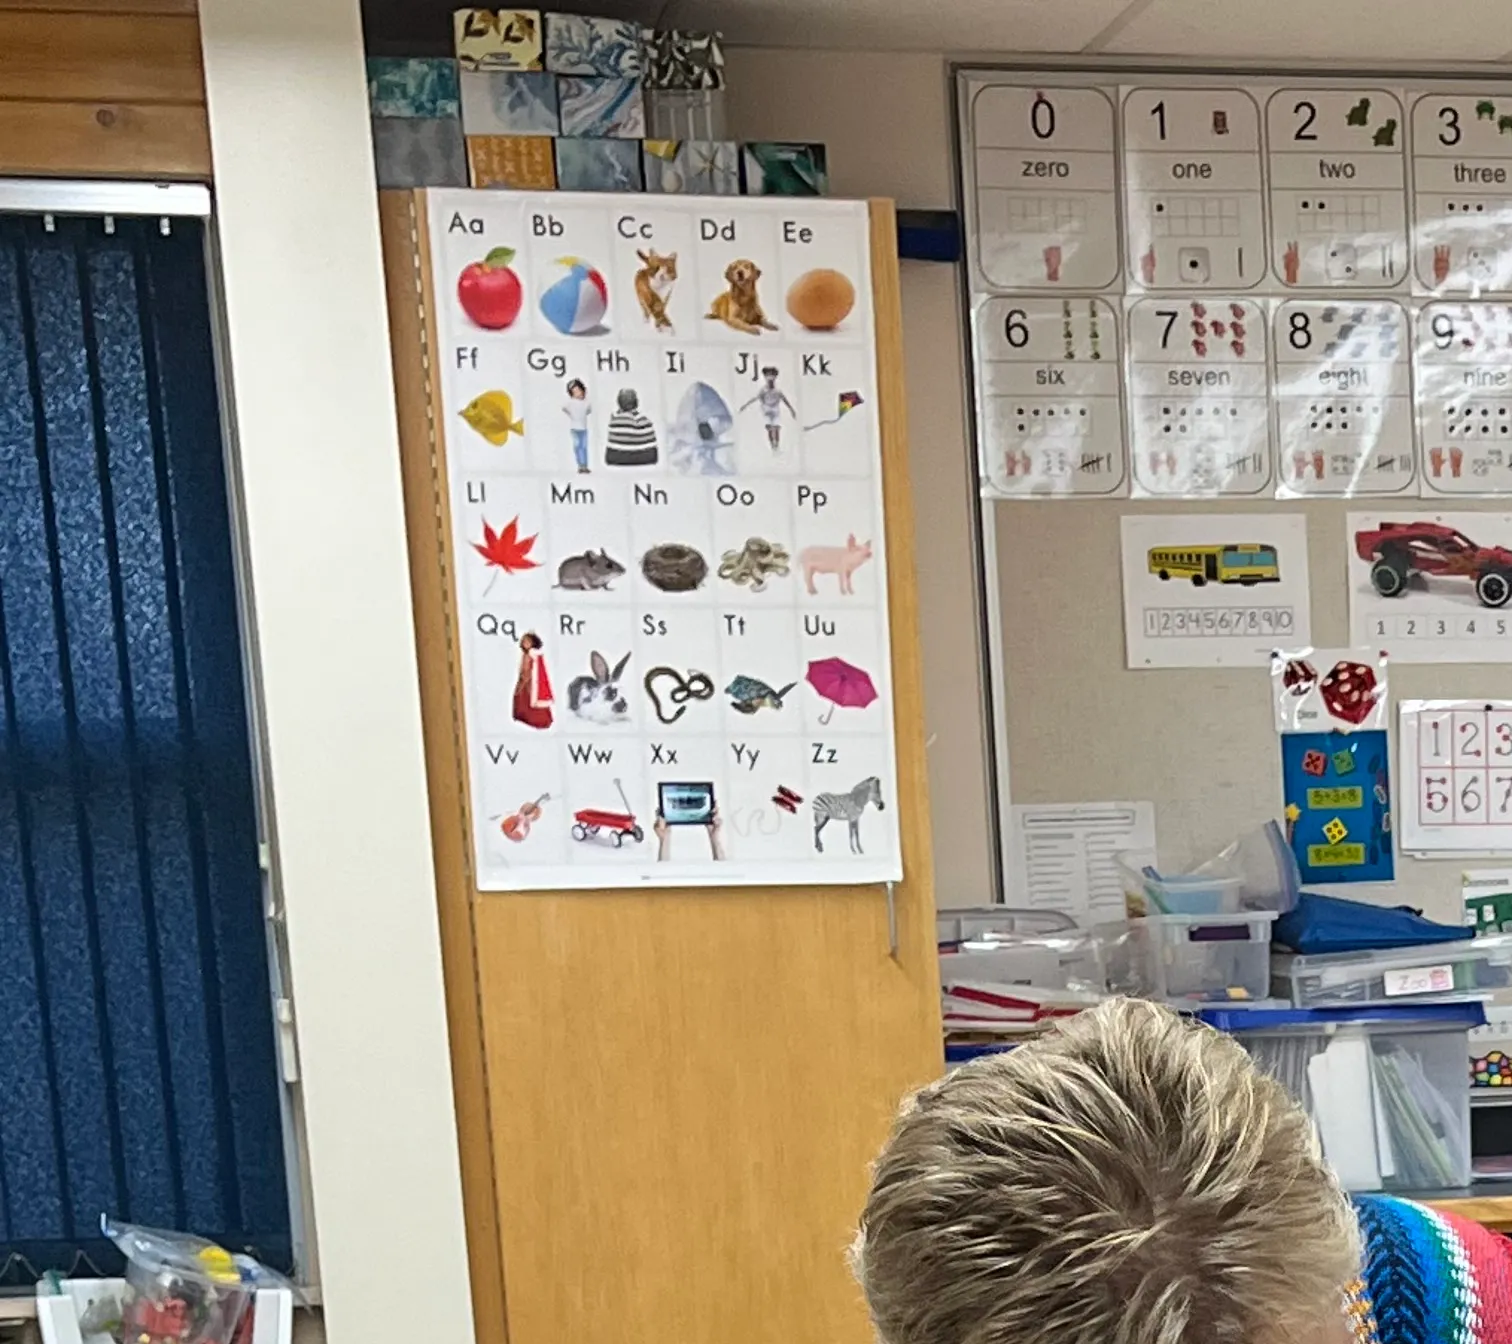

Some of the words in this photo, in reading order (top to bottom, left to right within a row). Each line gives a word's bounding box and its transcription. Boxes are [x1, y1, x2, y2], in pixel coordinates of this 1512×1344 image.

[1031, 99, 1056, 140] 0
[1150, 100, 1166, 141] 1
[1293, 101, 1319, 141] 2
[1438, 106, 1462, 146] 3
[1021, 159, 1070, 179] zero
[1172, 161, 1213, 180] one
[1319, 159, 1356, 179] two
[1453, 163, 1507, 184] three
[448, 212, 485, 236] Aa
[533, 214, 565, 237] Bb
[617, 216, 654, 240] Cc
[700, 218, 736, 242] Dd
[783, 221, 813, 244] Ee
[1004, 309, 1030, 348] 6
[1155, 311, 1179, 349] 7
[1288, 312, 1312, 350] 8
[1431, 313, 1455, 351] 9
[456, 347, 478, 370] Ff
[527, 349, 567, 376] Gg
[597, 350, 630, 373] Hh
[666, 351, 685, 373] Ii
[734, 352, 761, 380] Jj
[802, 353, 832, 376] Kk
[1036, 365, 1066, 386] six
[1168, 369, 1231, 388] seven
[1463, 366, 1508, 387] nine
[467, 481, 486, 504] Ll
[551, 483, 595, 505] Mm
[635, 484, 668, 506] Nn
[716, 484, 755, 507] Oo
[797, 485, 827, 513] Pp
[477, 614, 519, 642] Qq
[561, 614, 586, 637] Rr
[643, 615, 668, 637] Ss
[725, 615, 746, 637] Tt
[804, 615, 836, 637] Uu
[1377, 620, 1386, 635] 1
[1407, 620, 1416, 635] 2
[1437, 620, 1446, 635] 3
[1466, 620, 1476, 634] 4
[1496, 619, 1506, 635] 5
[1431, 721, 1441, 757] 1
[1459, 721, 1482, 757] 2
[485, 744, 519, 765] Vv
[568, 744, 613, 765] Ww
[650, 744, 678, 766] Xx
[731, 743, 761, 770] Yy
[812, 743, 838, 765] Zz
[1425, 776, 1449, 813] 5
[1460, 775, 1482, 813] 6
